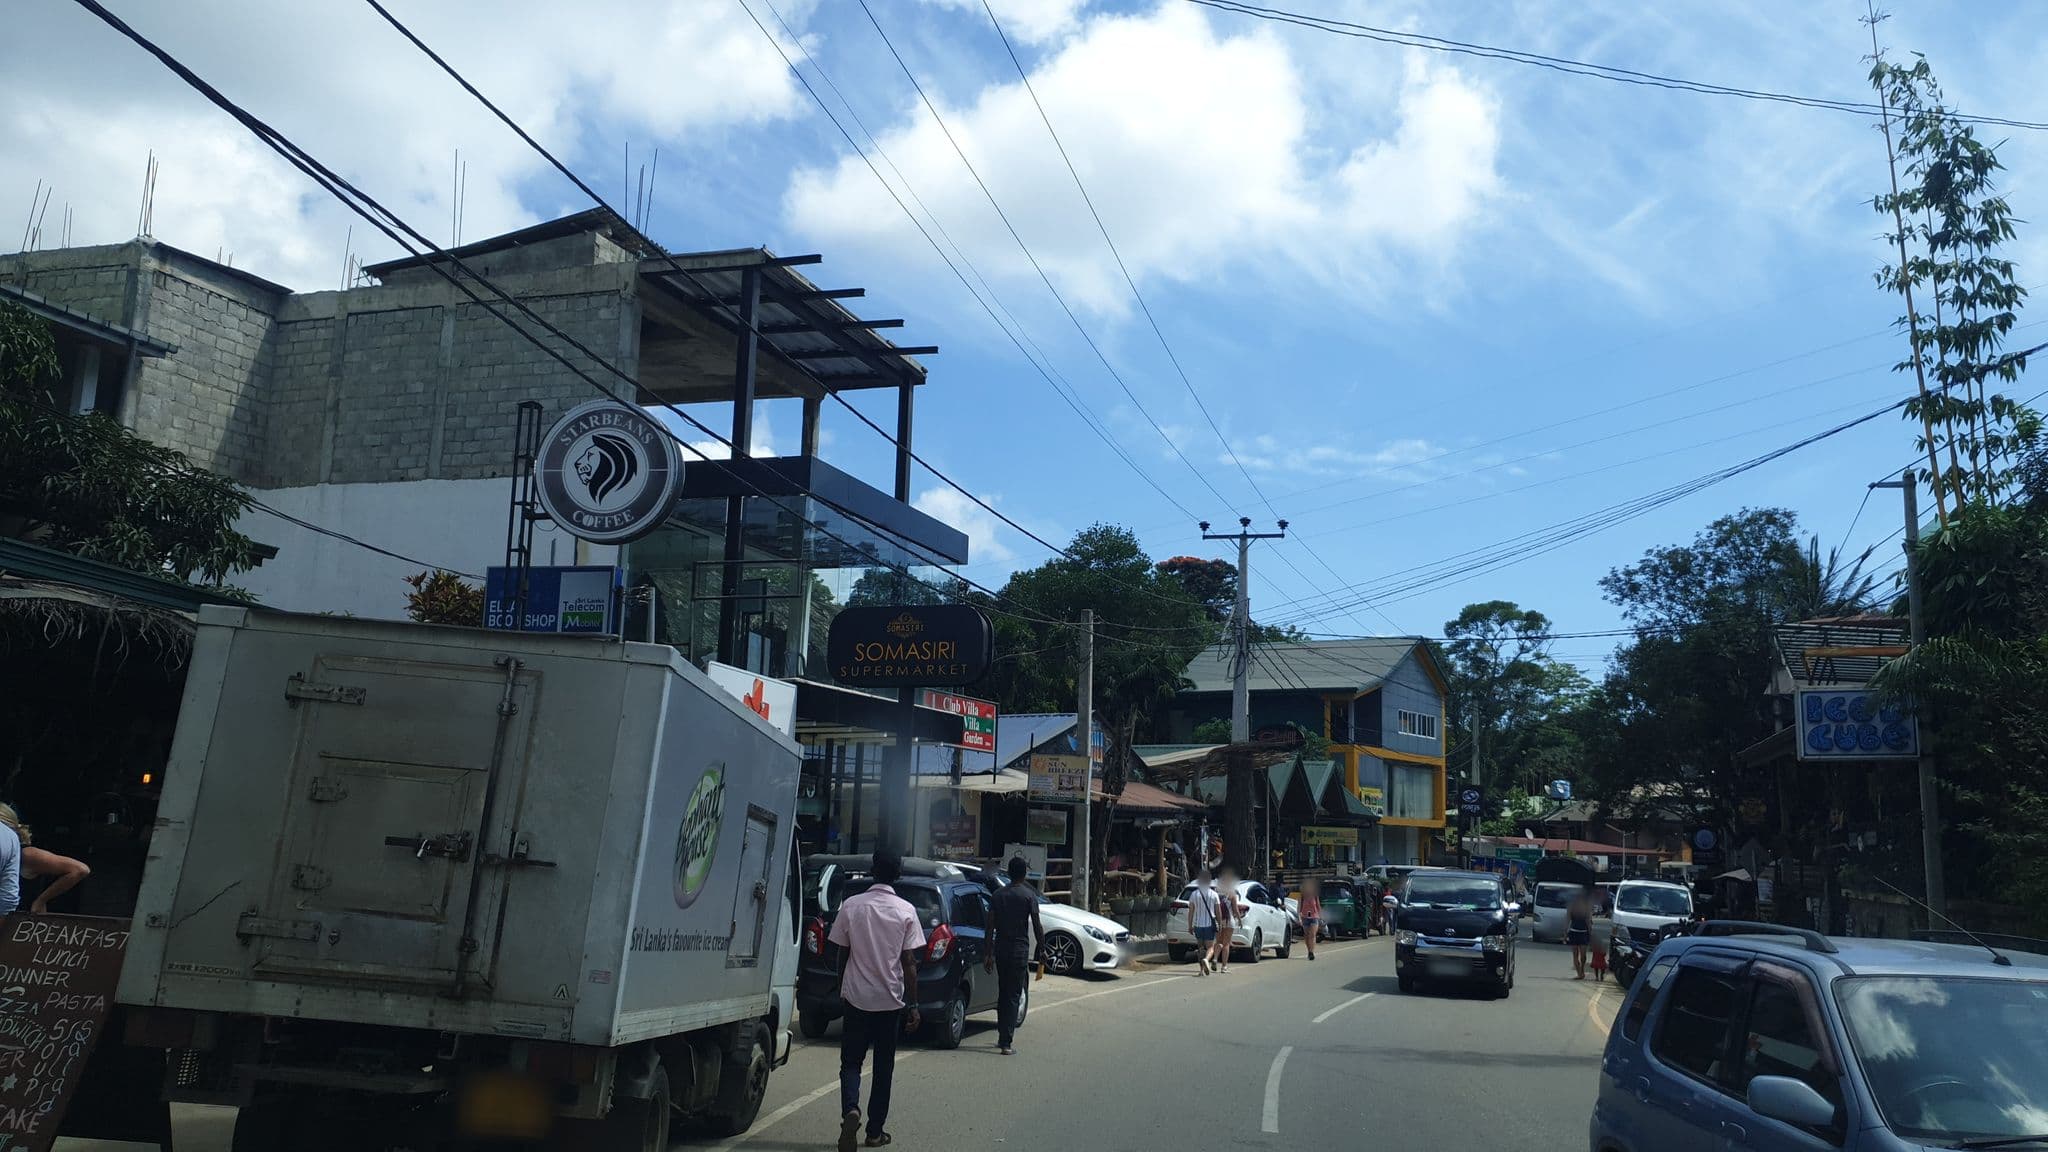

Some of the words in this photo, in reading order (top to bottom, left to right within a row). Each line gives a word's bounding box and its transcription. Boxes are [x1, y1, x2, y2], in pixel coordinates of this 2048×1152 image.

[560, 412, 655, 447] STARBEANS
[572, 509, 635, 528] COFFEE
[562, 600, 605, 611] Telecom
[524, 614, 556, 627] SHOP
[854, 641, 956, 662] SOMASIRI
[840, 664, 968, 678] SUPERMARKET
[943, 696, 961, 713] Club
[962, 700, 979, 716] Villa
[963, 715, 980, 731] Villa
[963, 731, 984, 745] Garden
[1807, 723, 1911, 751] CUBE
[1047, 760, 1067, 768] SUN
[12, 921, 131, 950] BREAKFAST
[630, 926, 644, 952] Sri
[643, 927, 672, 952] Lanka's
[671, 928, 701, 952] favourite
[702, 930, 711, 951] ice
[43, 991, 105, 1013] PASTA
